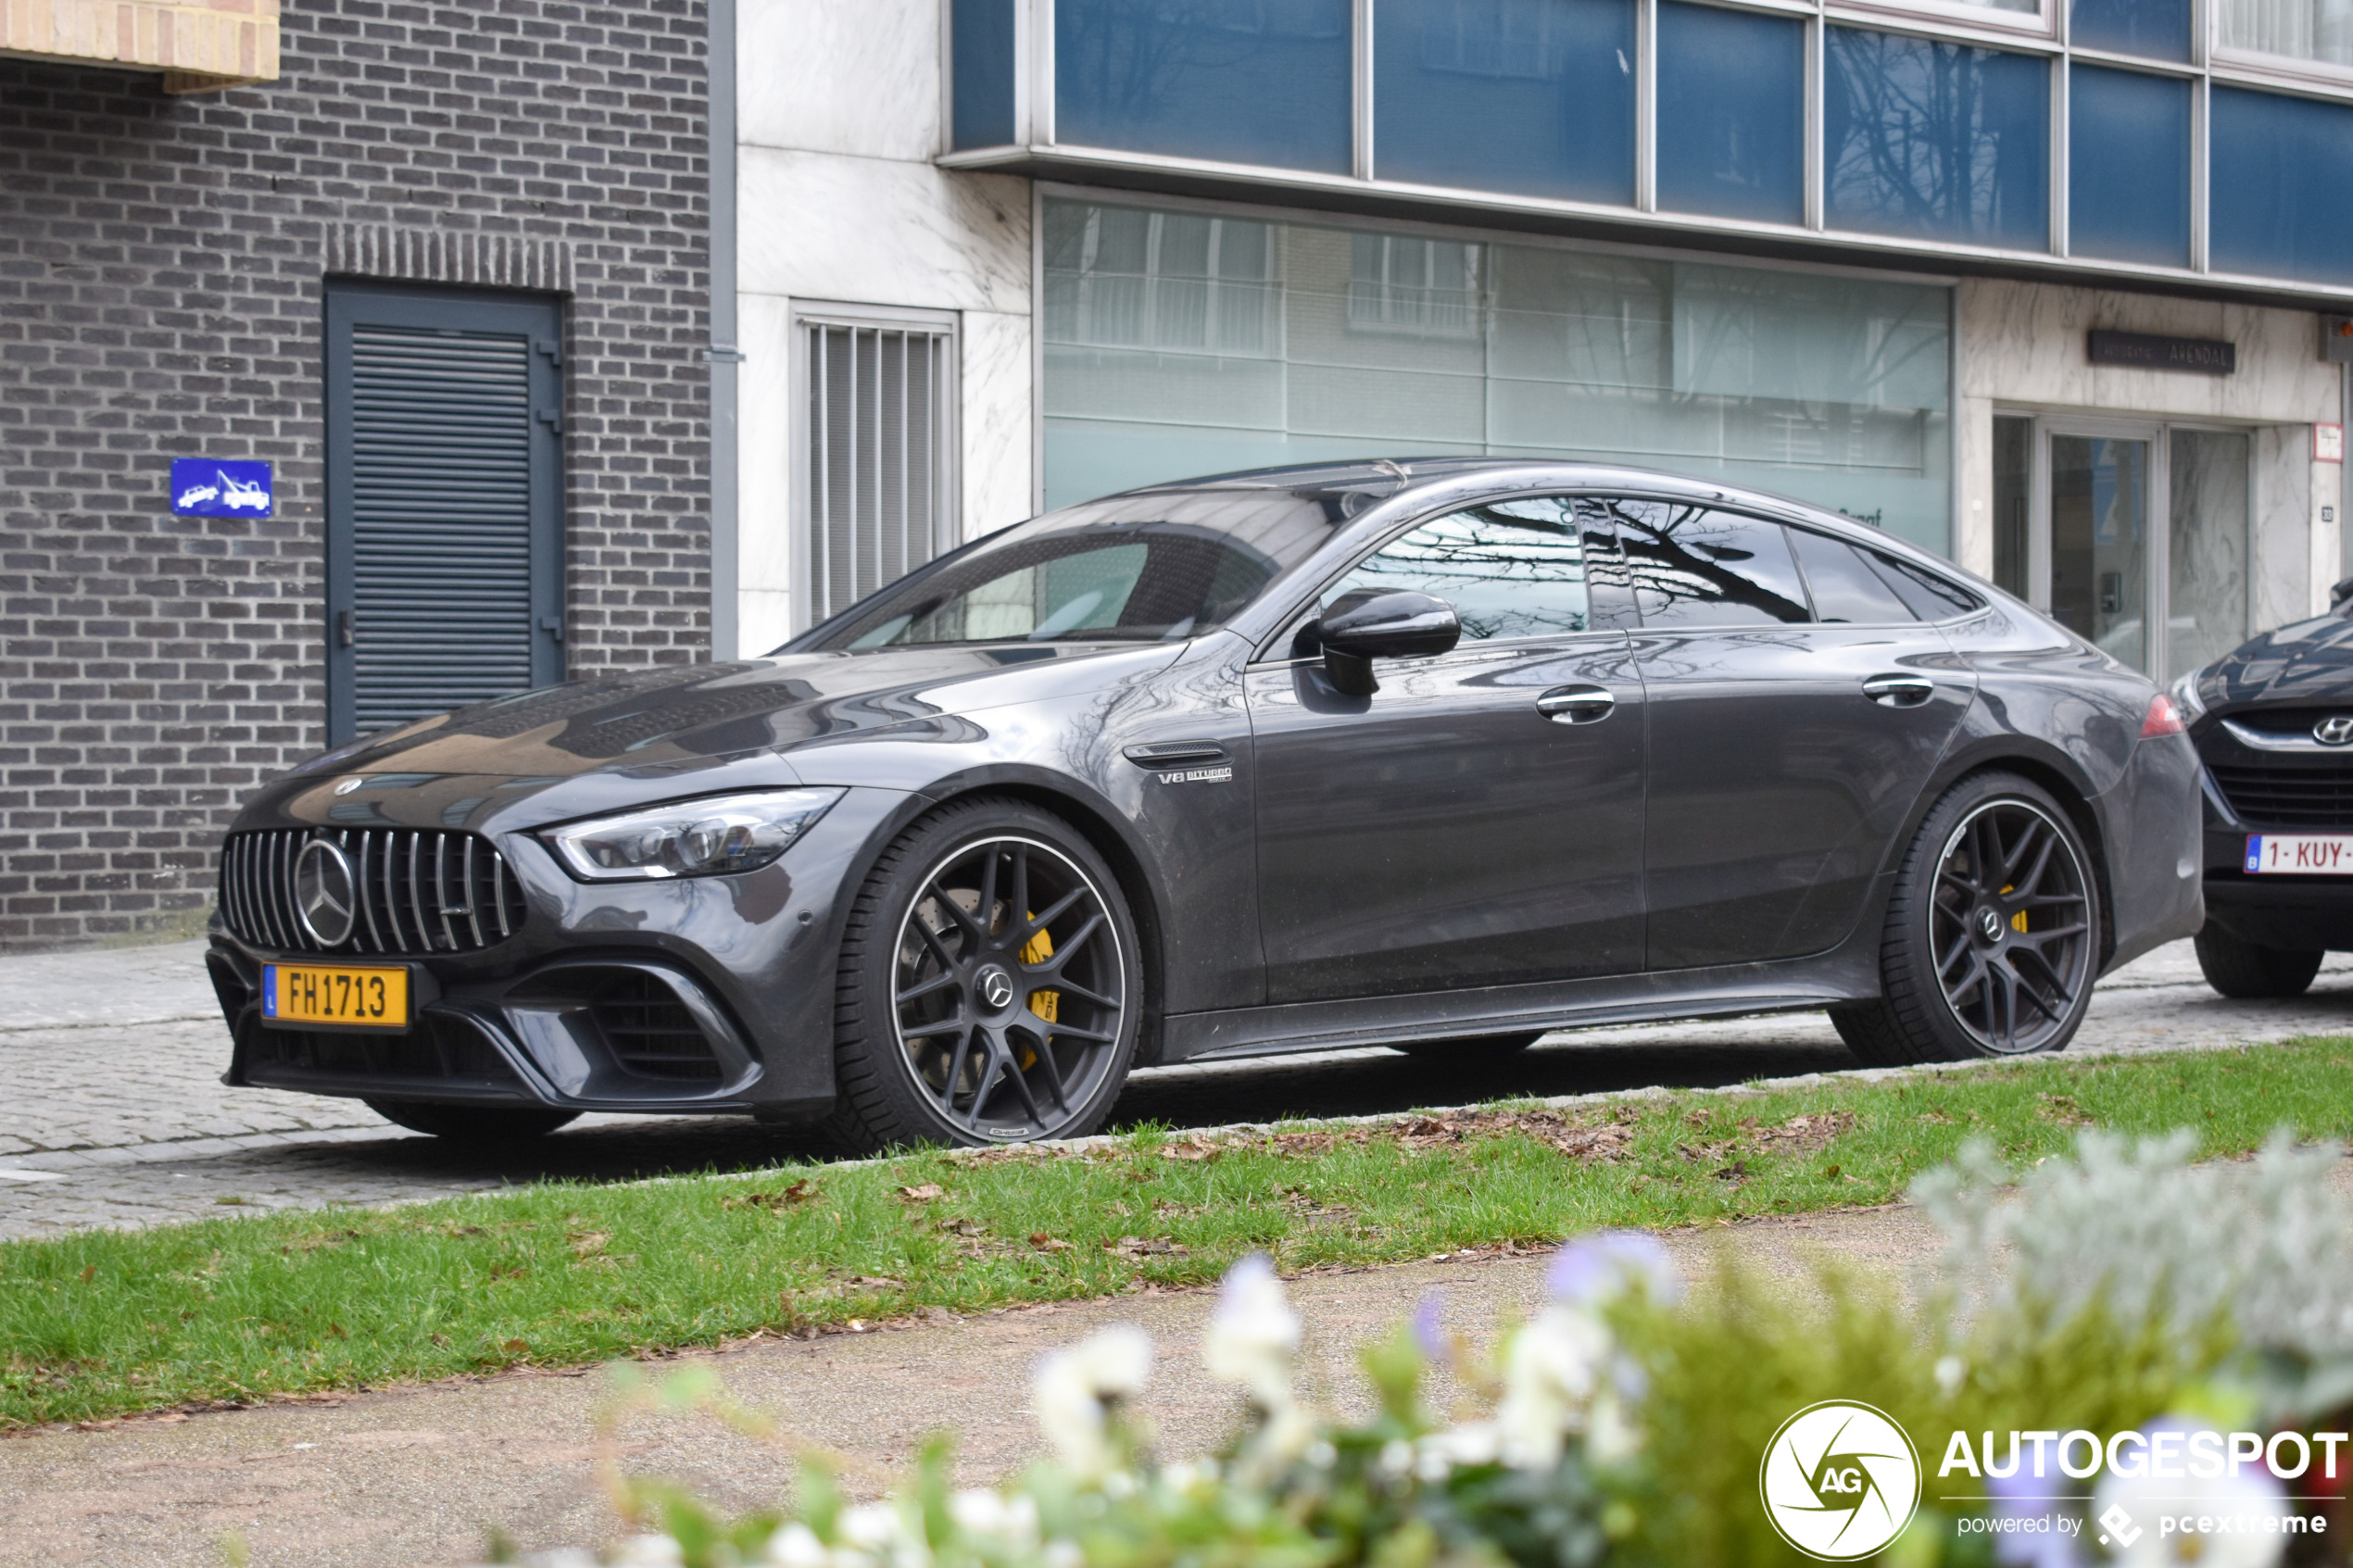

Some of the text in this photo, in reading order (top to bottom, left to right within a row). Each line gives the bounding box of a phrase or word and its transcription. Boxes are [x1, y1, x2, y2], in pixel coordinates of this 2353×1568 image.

[2170, 344, 2227, 367] ARENDAL
[1158, 767, 1232, 784] V8 BITURBO
[2246, 856, 2259, 870] B
[268, 995, 274, 1010] L
[290, 972, 385, 1017] FH1713
